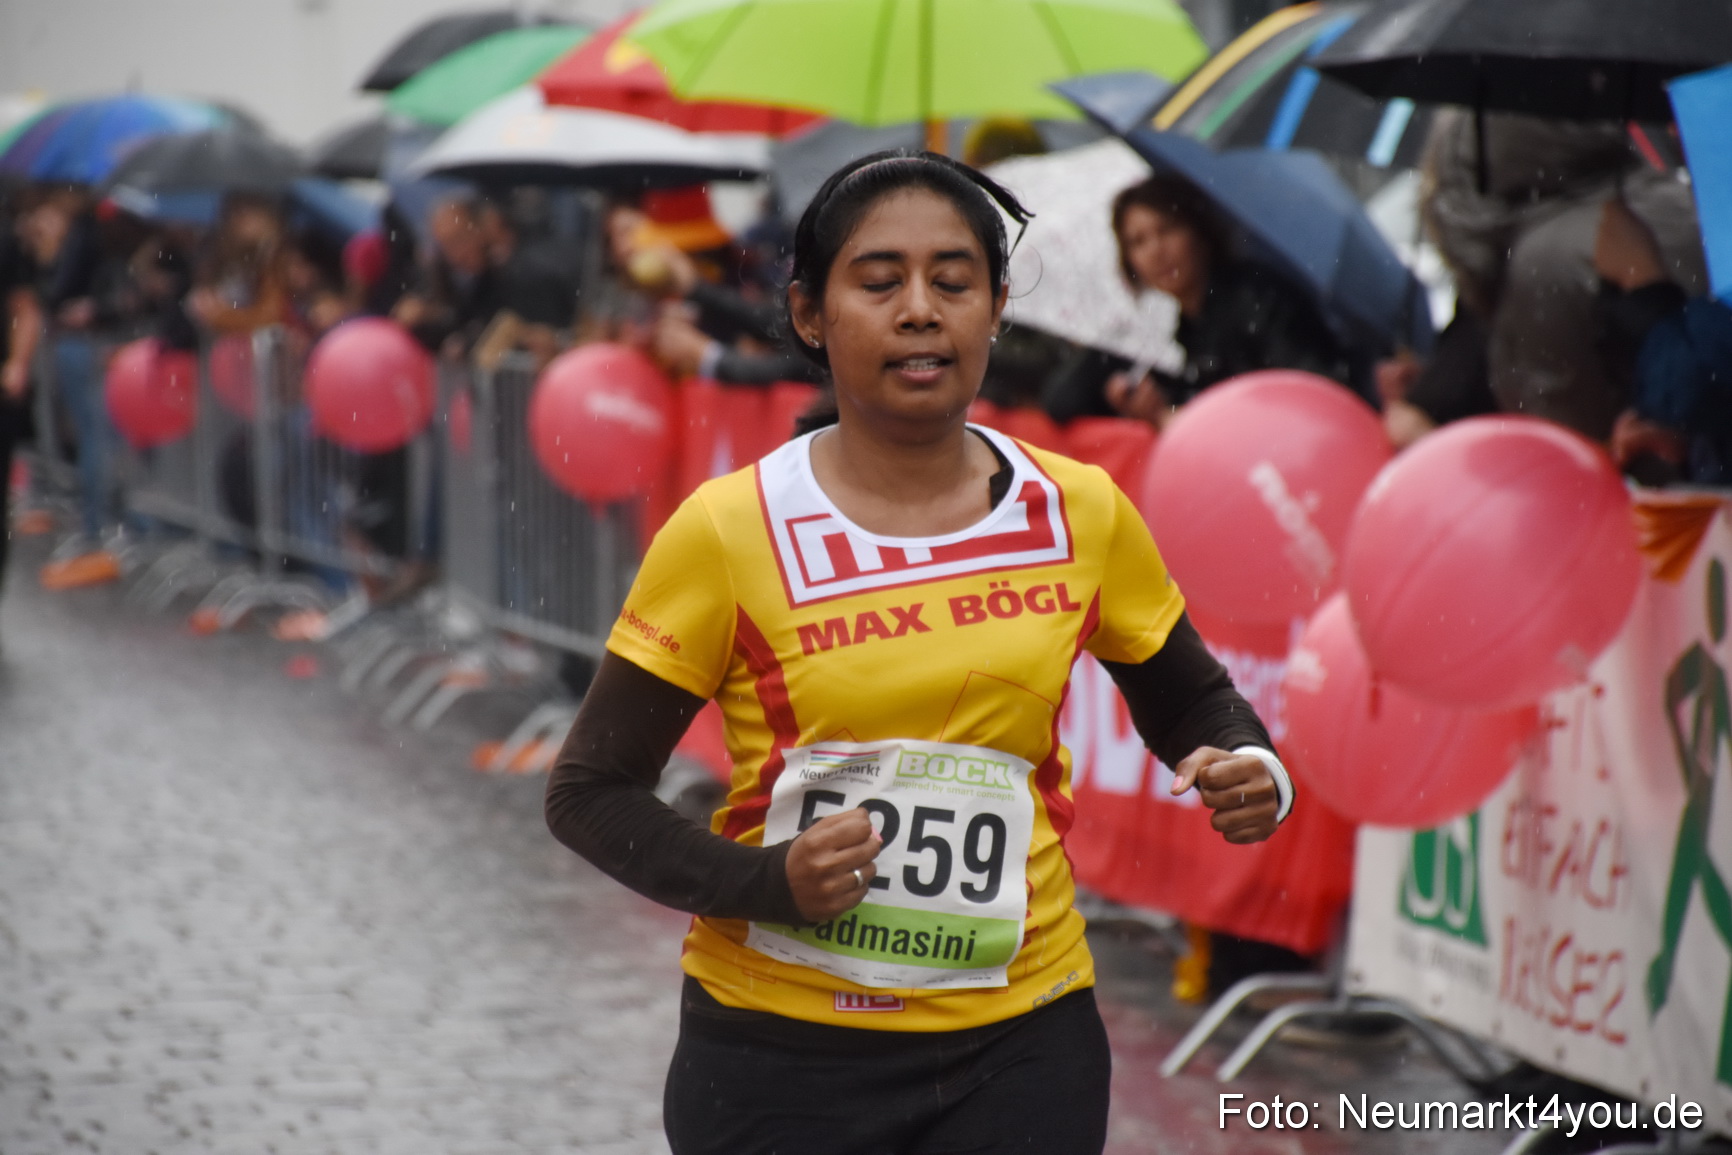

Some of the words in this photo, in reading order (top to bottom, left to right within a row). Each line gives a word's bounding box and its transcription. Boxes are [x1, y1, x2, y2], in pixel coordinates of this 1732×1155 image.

[796, 602, 932, 656] MAX
[947, 581, 1082, 627] BÖGL
[892, 779, 929, 790] inspired
[932, 781, 945, 794] by
[947, 784, 974, 796] smart
[976, 789, 1016, 802] concepts
[896, 750, 1014, 790] BOCK
[793, 914, 976, 961] admasini
